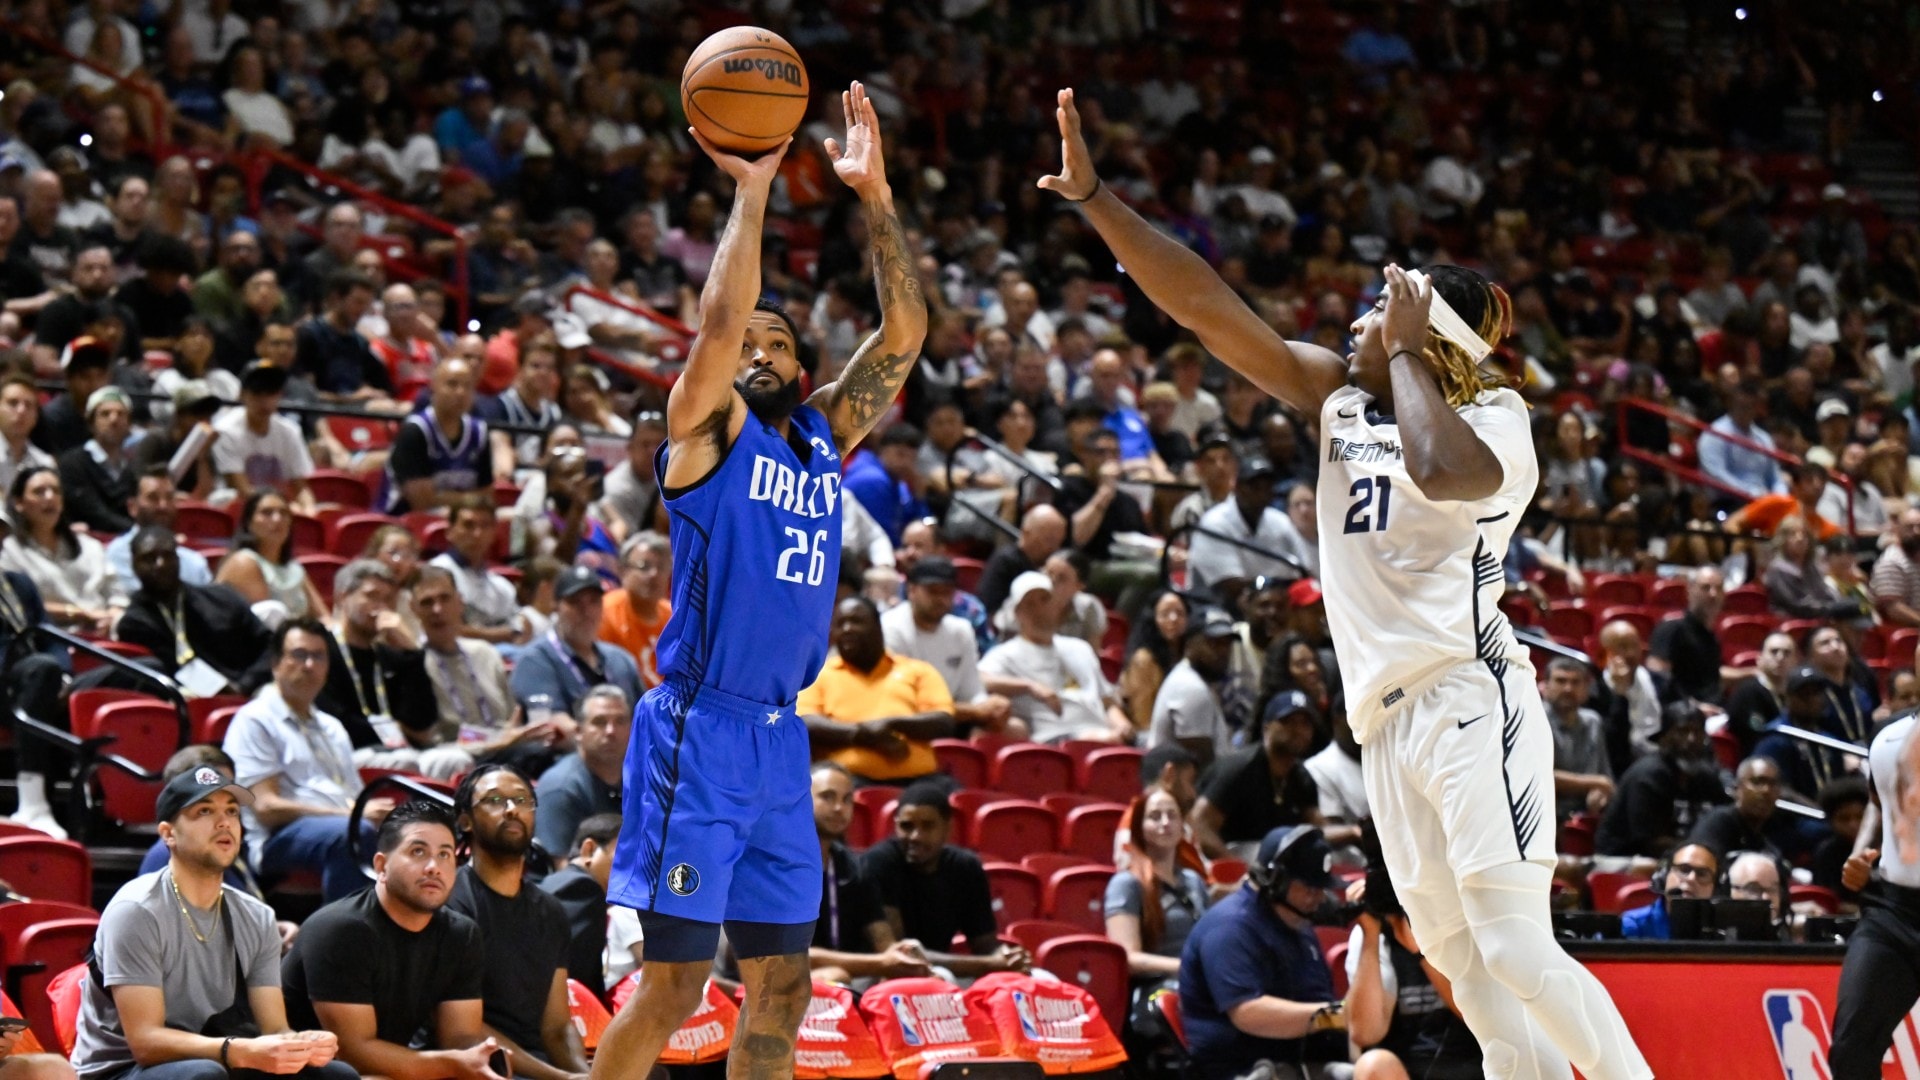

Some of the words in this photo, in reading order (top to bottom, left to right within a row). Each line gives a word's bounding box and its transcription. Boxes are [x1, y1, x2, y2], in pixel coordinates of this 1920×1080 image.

[724, 58, 802, 87] Wilson
[1343, 475, 1391, 534] 21
[776, 526, 827, 586] 26
[920, 1017, 972, 1044] LEAGUE
